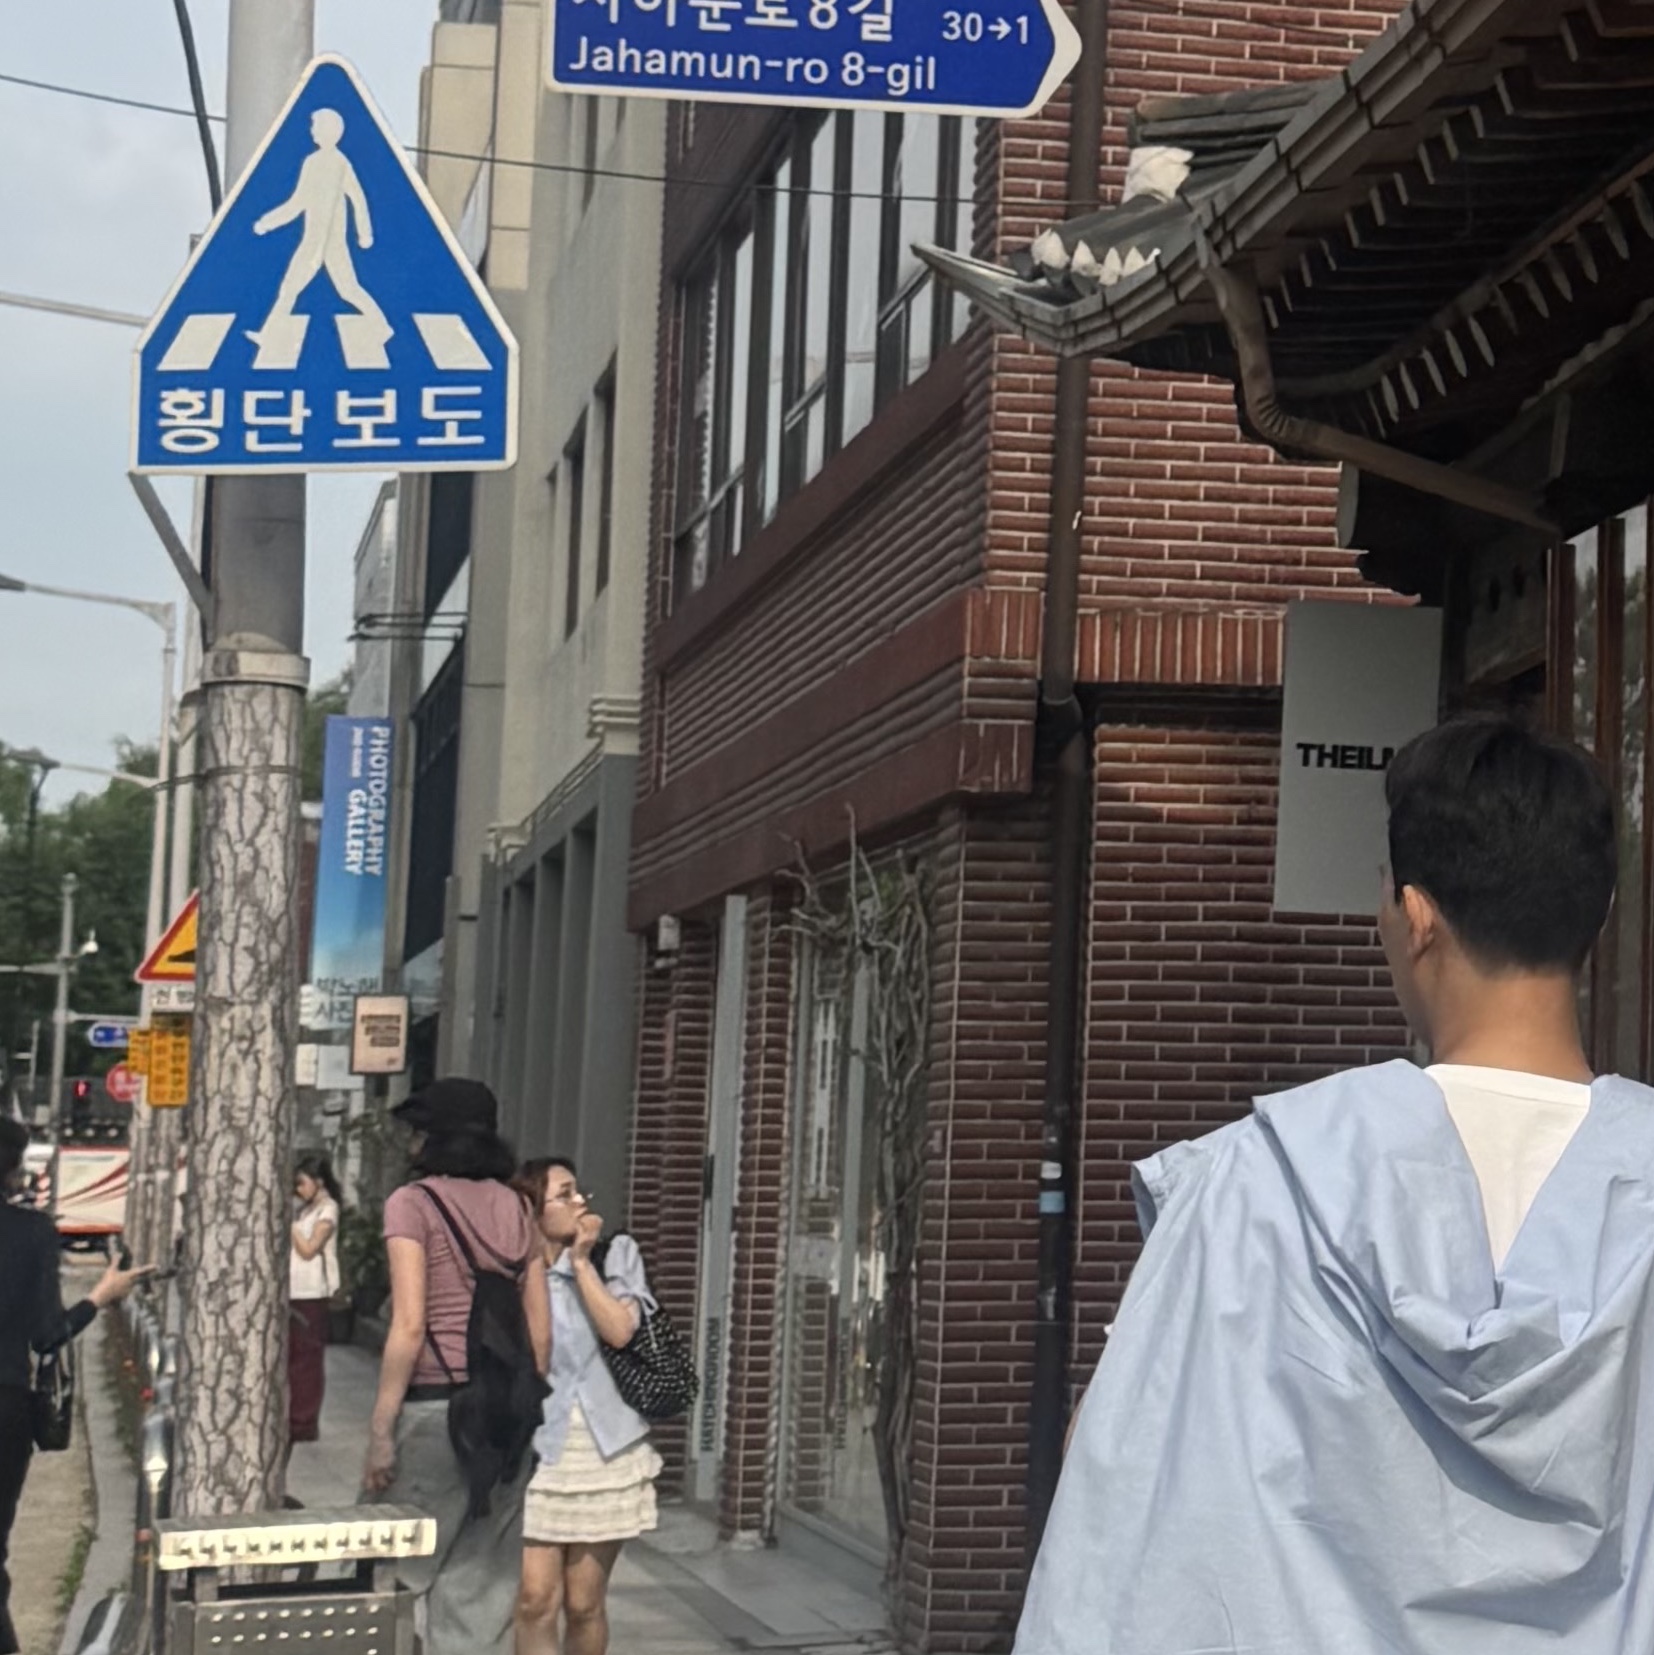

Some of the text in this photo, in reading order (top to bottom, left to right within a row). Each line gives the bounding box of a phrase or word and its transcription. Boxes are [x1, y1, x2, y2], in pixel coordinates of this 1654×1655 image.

[569, 36, 936, 96] Jahamun-ro 8-gil
[158, 386, 486, 453] 횡단보도
[345, 788, 367, 875] GALLERY
[365, 726, 391, 876] PHOTOGRAPHY
